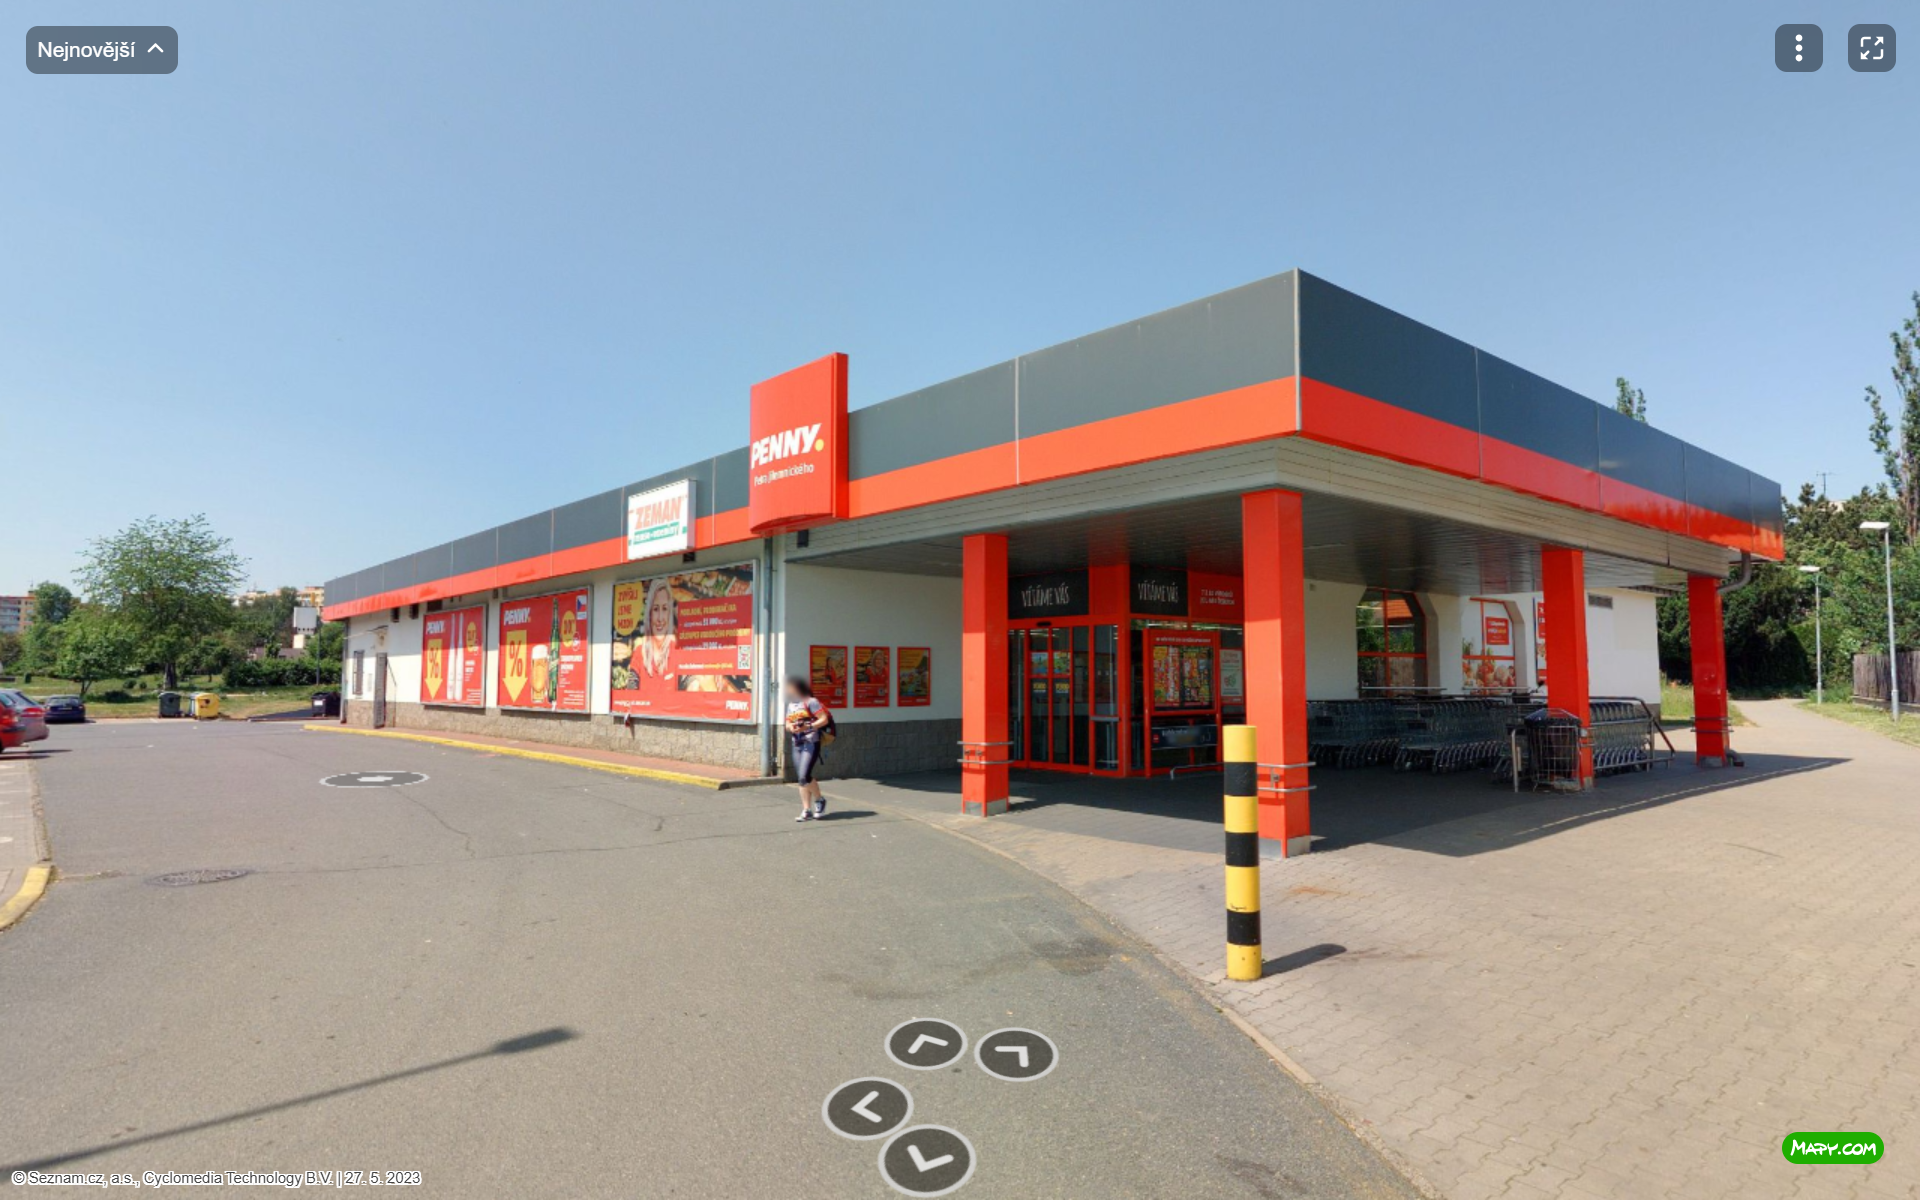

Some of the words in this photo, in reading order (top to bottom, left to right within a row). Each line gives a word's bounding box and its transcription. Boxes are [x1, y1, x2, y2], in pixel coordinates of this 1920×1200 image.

[635, 496, 682, 529] ZEMAN
[1021, 584, 1054, 607] VÍTÁME
[1055, 582, 1070, 606] VÁS
[1138, 580, 1166, 602] VÍTÁME
[1166, 582, 1179, 602] VÁS
